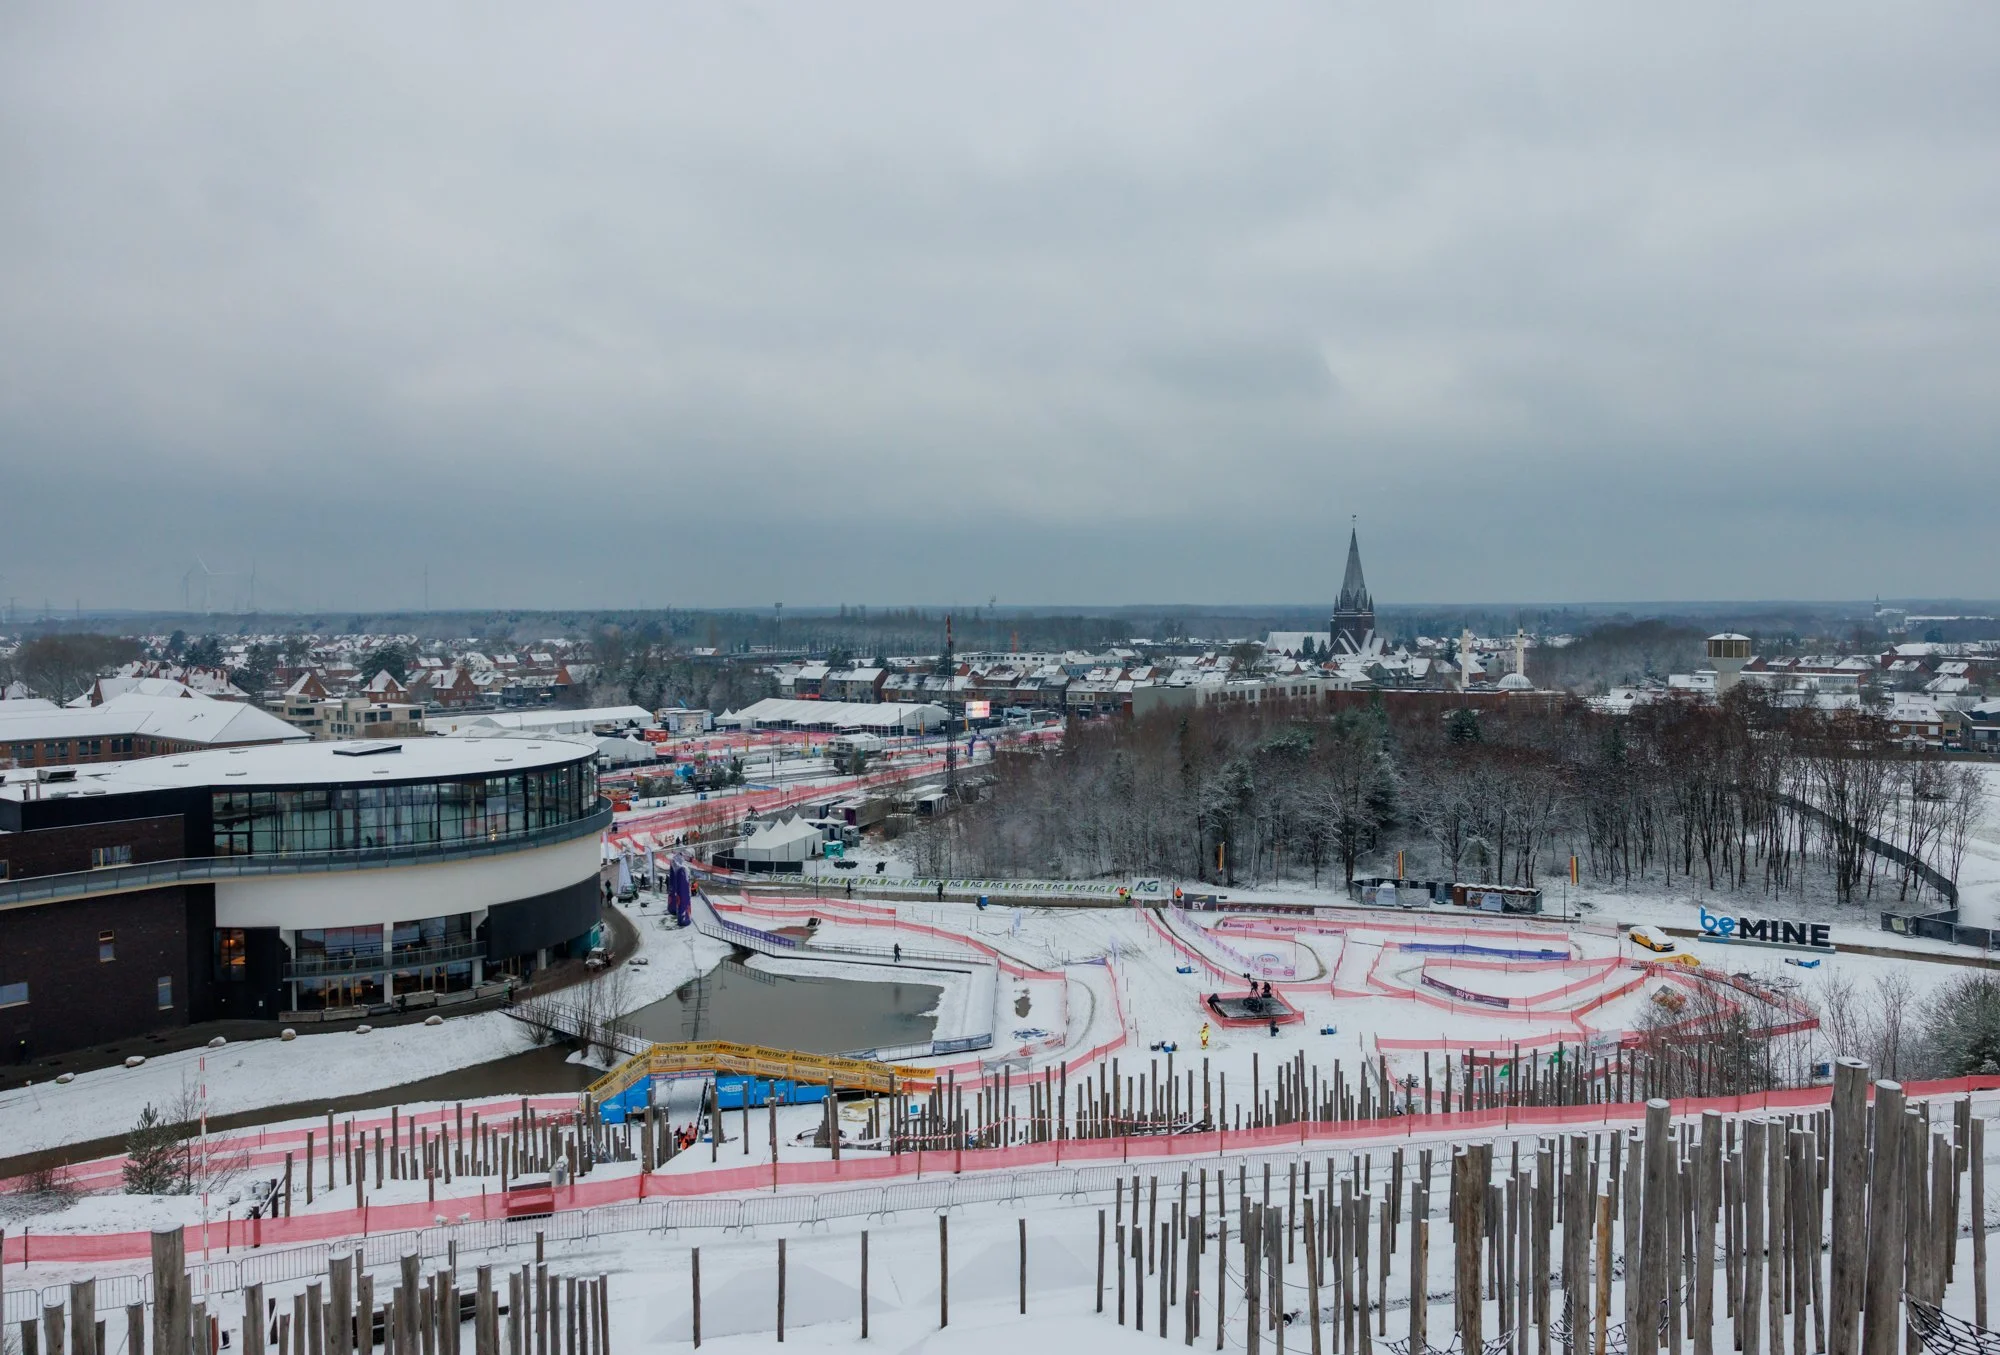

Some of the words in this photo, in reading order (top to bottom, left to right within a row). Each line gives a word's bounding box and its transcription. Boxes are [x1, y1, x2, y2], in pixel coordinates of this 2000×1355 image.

[1134, 880, 1159, 892] AG
[1192, 901, 1206, 910] EY
[1455, 989, 1475, 1000] SUYS
